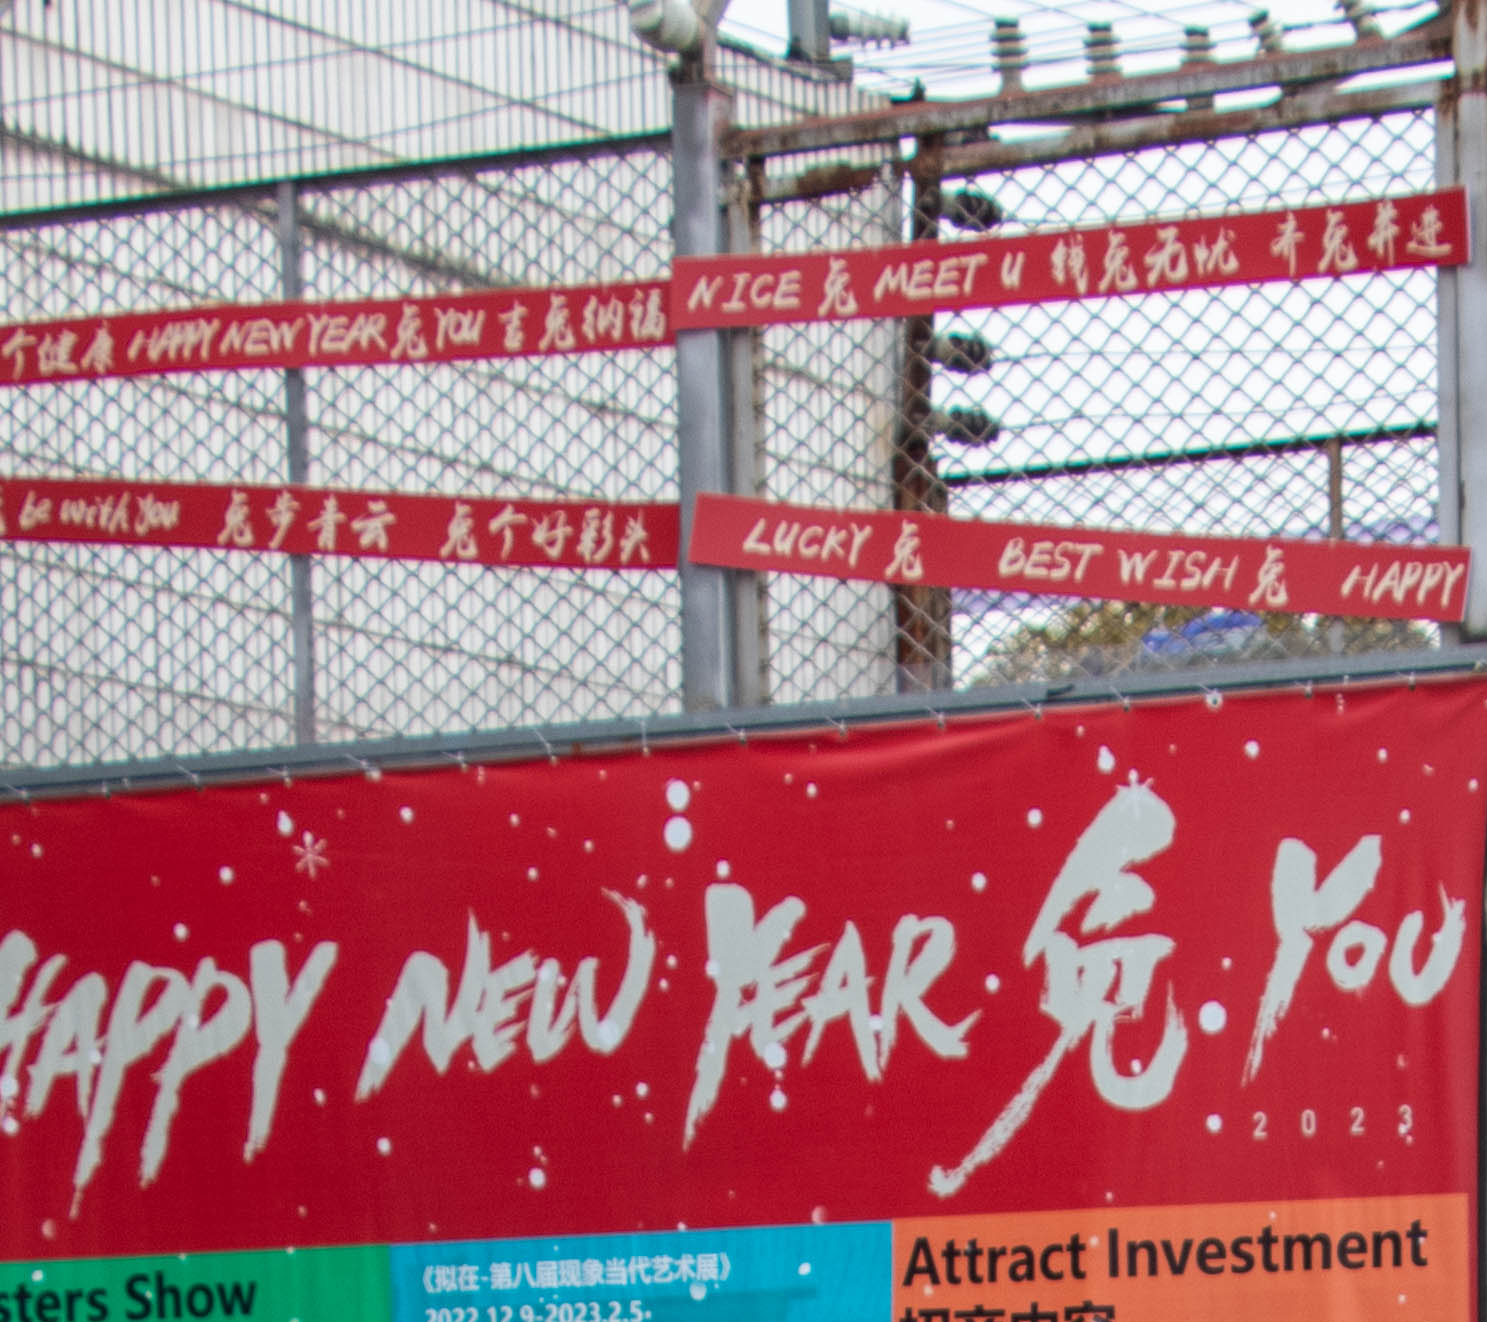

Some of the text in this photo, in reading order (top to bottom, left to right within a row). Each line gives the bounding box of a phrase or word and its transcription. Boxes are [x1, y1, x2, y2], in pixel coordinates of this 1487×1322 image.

[688, 270, 801, 312] NICE
[818, 256, 858, 316] 兔
[874, 254, 988, 301] MEET
[1002, 252, 1025, 288] U
[127, 318, 220, 362] HAPPY
[220, 317, 304, 357] NEW
[307, 313, 387, 356] YEAR
[390, 302, 427, 360] 兔
[435, 307, 485, 351] YOU
[498, 289, 667, 352] 吉兔纳福
[19, 491, 52, 530] be
[59, 491, 130, 534] with
[742, 518, 1464, 608] LUCKY 兔 BEST WISH 兔 HAPPY
[353, 886, 656, 1103] NEW
[682, 882, 982, 1152] YEAR
[928, 780, 1188, 1198] 兔
[1242, 834, 1465, 1087] YOU
[903, 1219, 1429, 1287] Attract Investment
[124, 1270, 258, 1321] Show
